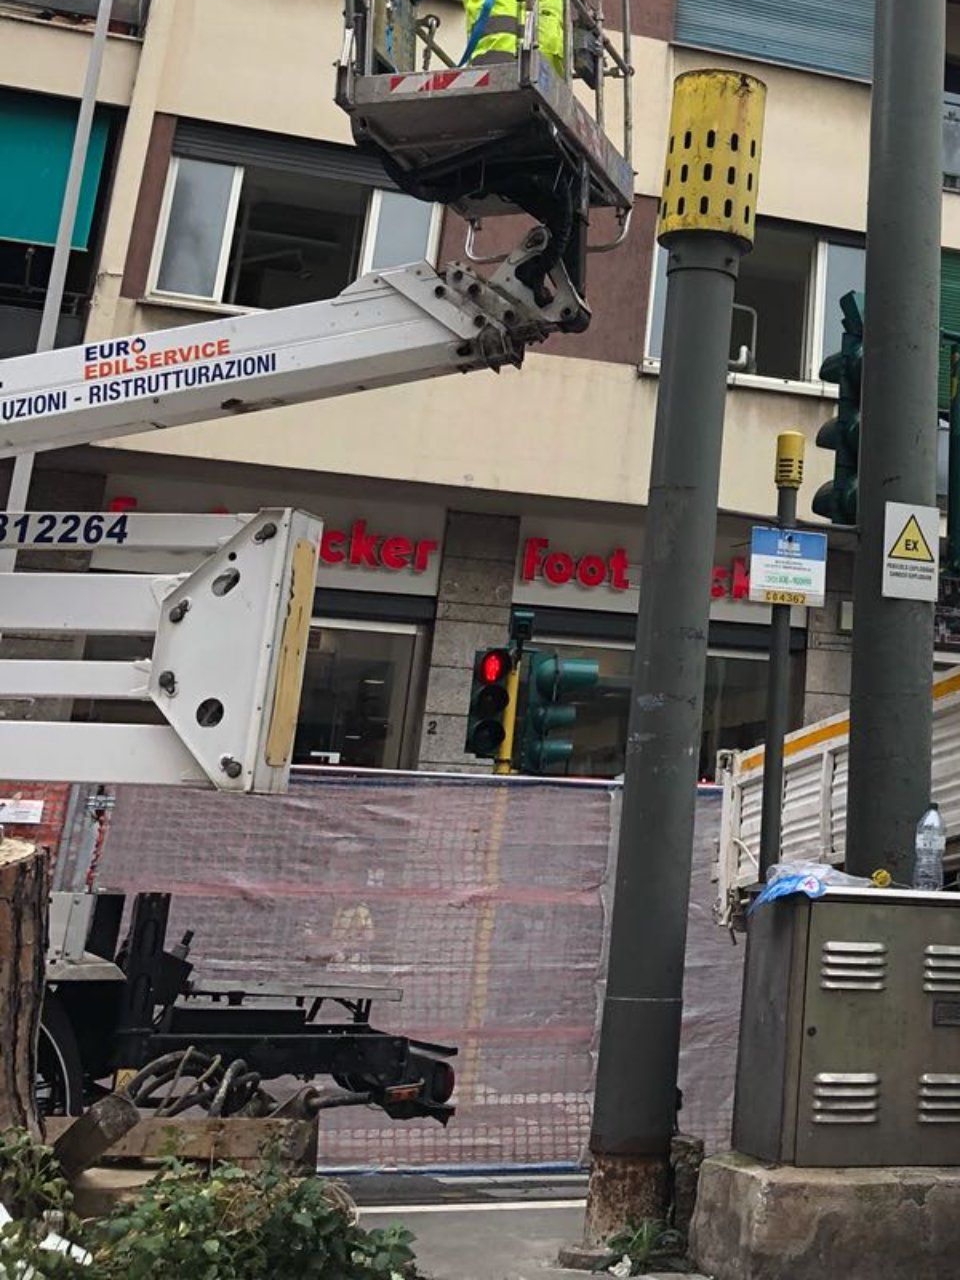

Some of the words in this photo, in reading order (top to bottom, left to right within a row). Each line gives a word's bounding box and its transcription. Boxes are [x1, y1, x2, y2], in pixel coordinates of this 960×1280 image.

[84, 339, 230, 381] EDILSERVICE
[85, 337, 146, 362] EURO
[88, 352, 277, 404] RISTRUTTURAZIONI
[320, 519, 438, 573] cker
[521, 536, 630, 591] Foot
[904, 538, 919, 552] EX
